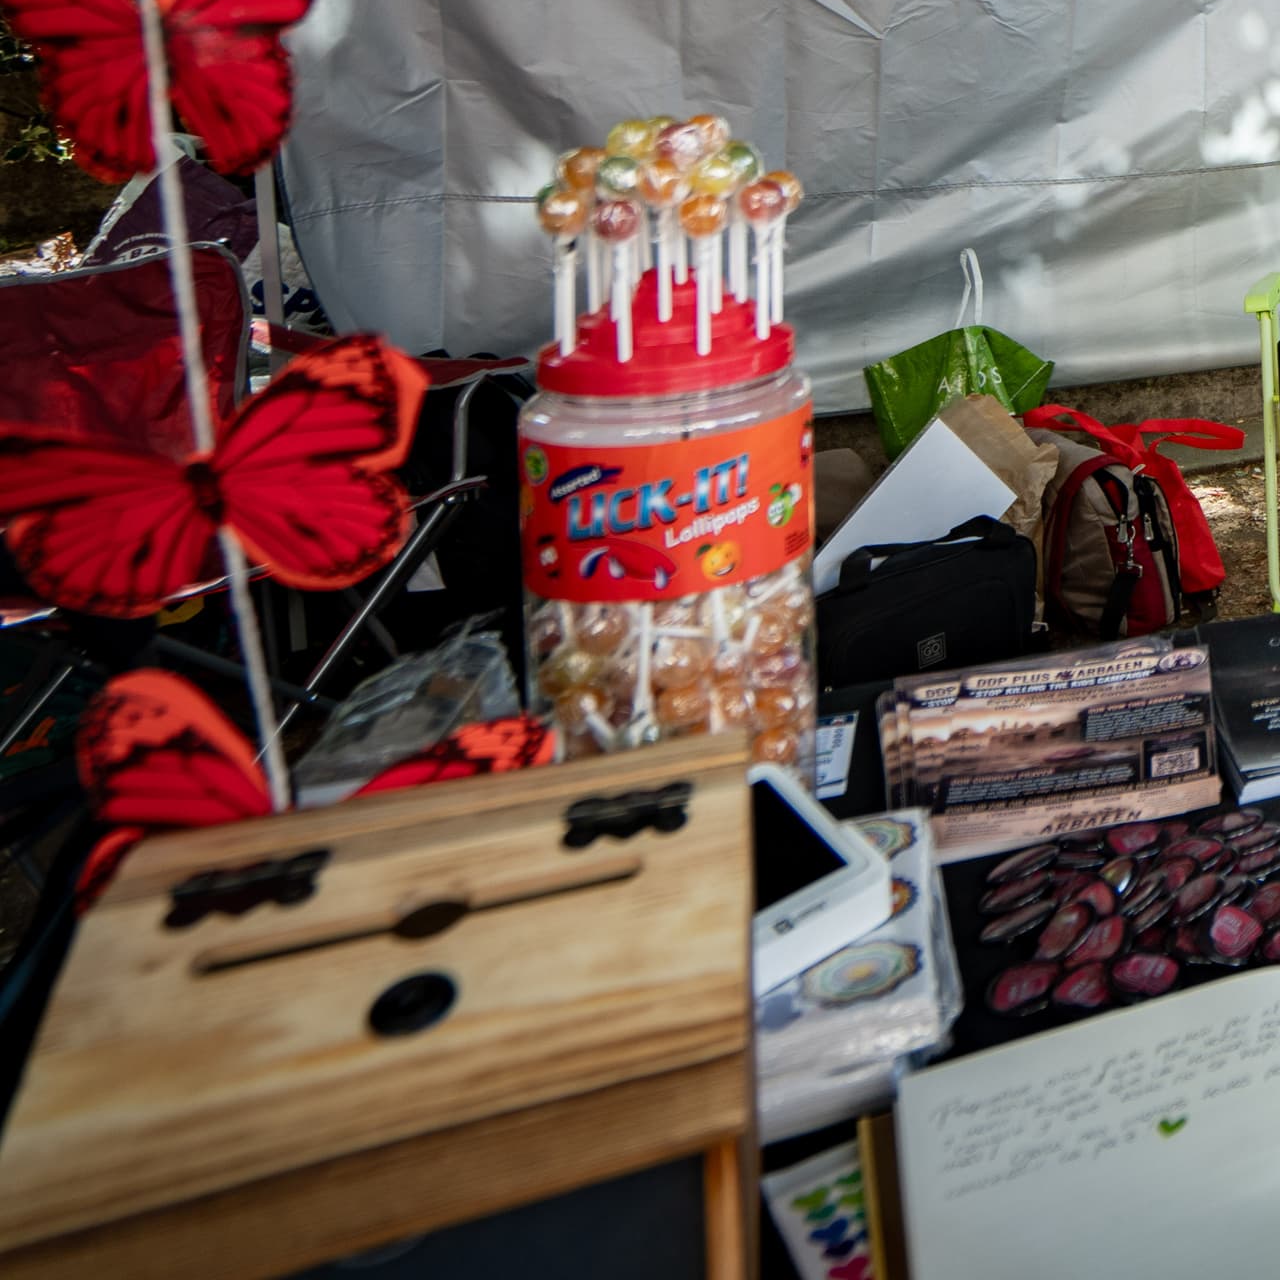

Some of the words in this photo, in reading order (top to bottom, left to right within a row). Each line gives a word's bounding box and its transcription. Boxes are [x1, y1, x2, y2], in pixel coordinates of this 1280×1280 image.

[566, 453, 750, 543] LICK-IT!
[664, 496, 760, 549] Lollipops
[1005, 683, 1047, 697] KILLING
[1048, 680, 1069, 692] THE
[1070, 677, 1095, 690] KIDS
[1013, 672, 1050, 686] PLUS
